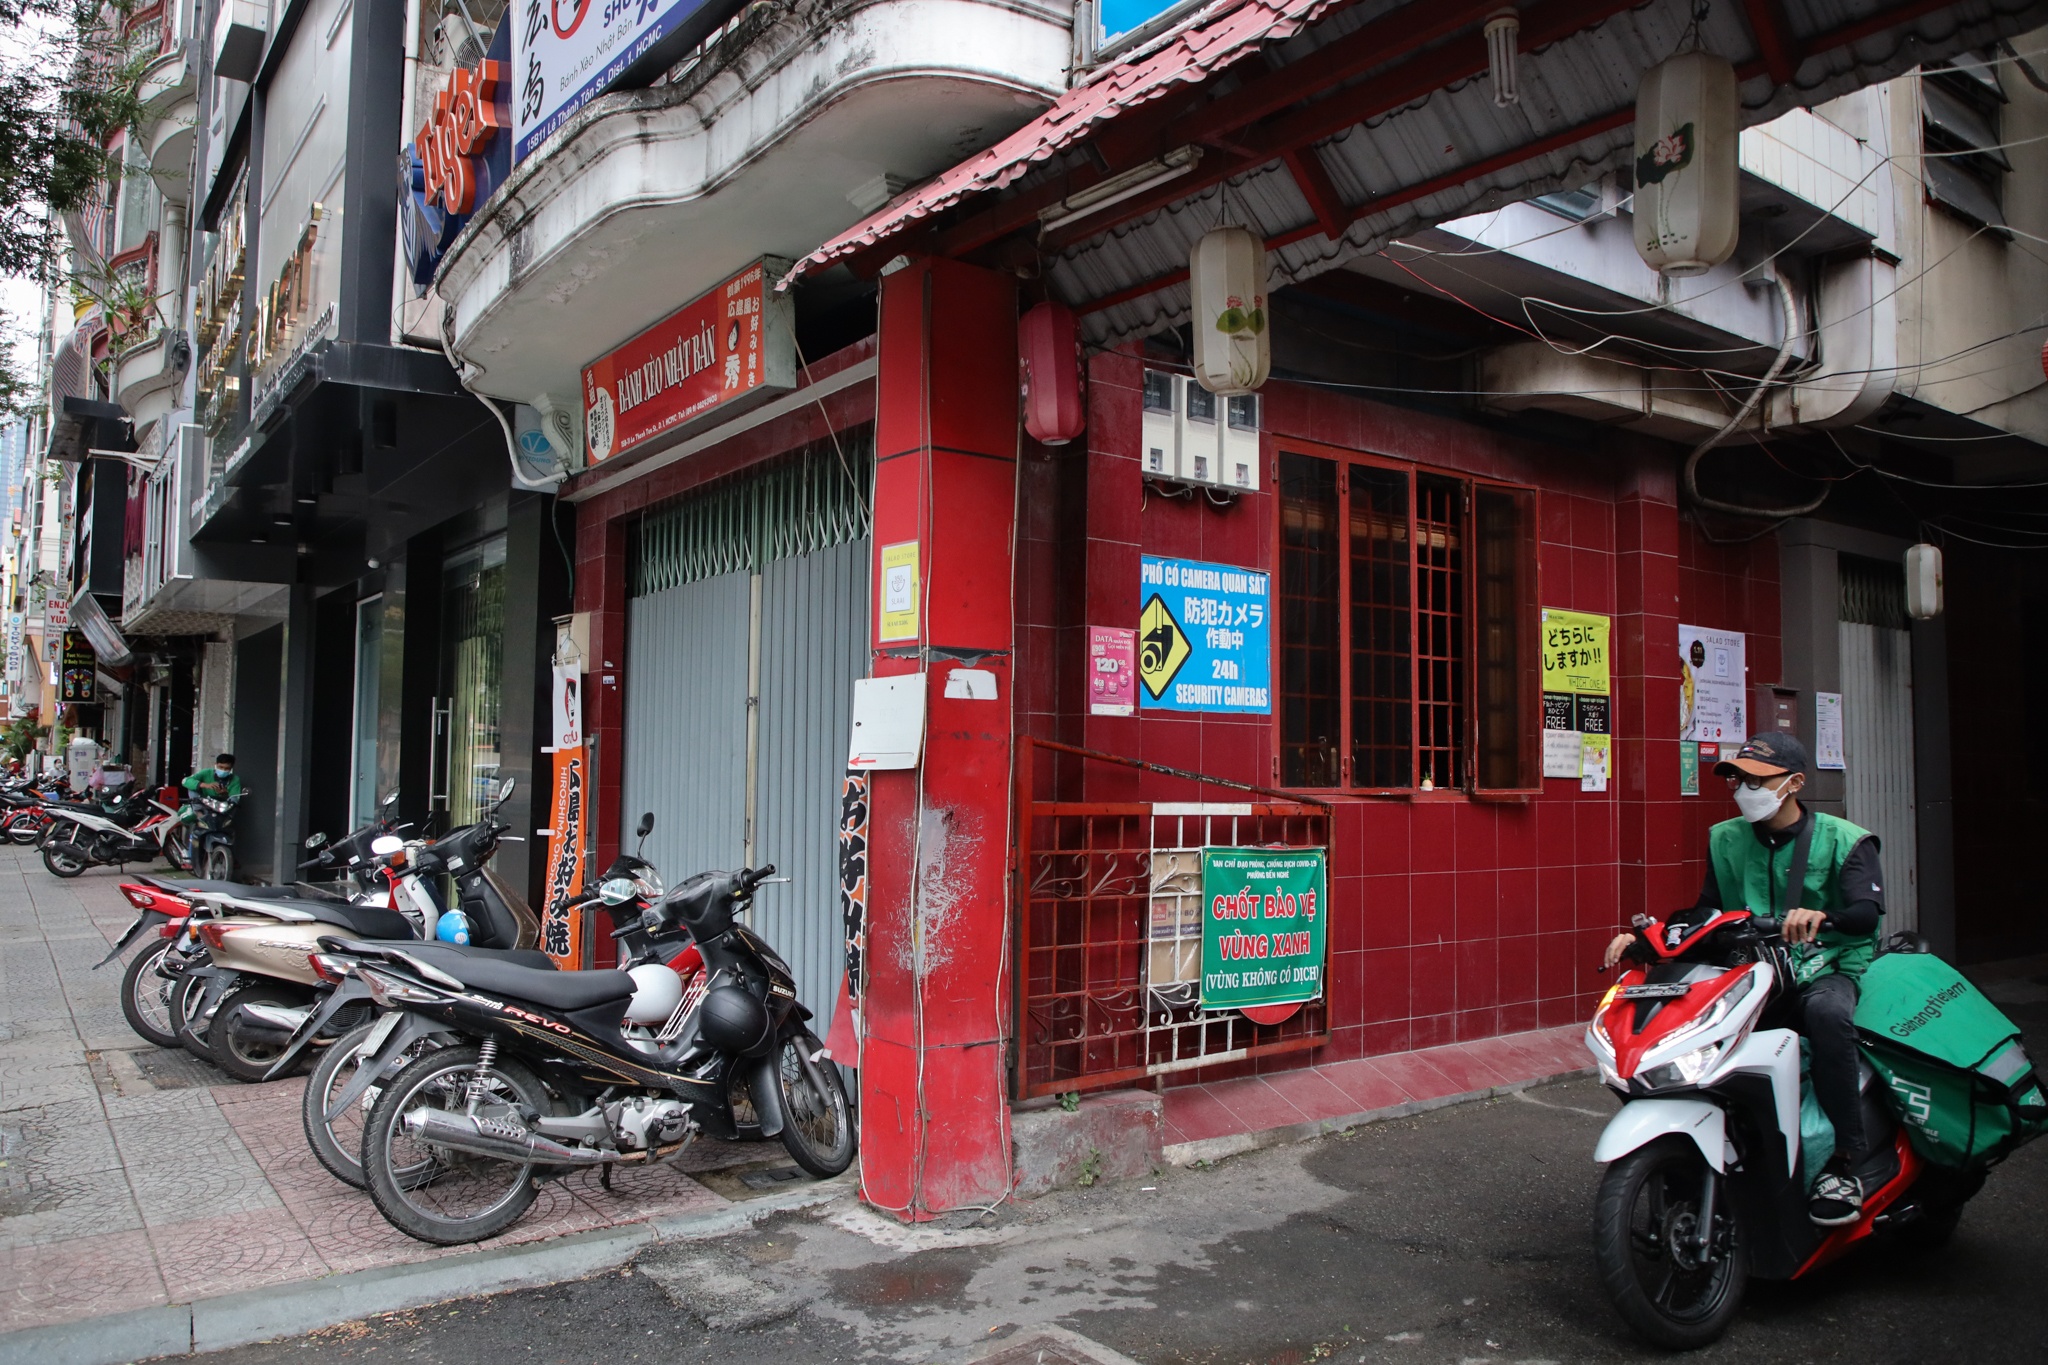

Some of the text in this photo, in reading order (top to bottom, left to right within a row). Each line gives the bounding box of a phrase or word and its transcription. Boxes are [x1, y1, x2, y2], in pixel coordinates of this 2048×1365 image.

[560, 18, 633, 92] Bánh Xèo Nhật Bản
[526, 127, 547, 152] 15B11
[547, 116, 557, 135] Lê
[558, 99, 579, 123] Thánh
[580, 86, 594, 106] Tôn
[595, 75, 606, 93] St.
[607, 61, 627, 86] Dist.
[636, 24, 662, 59] HCMC
[415, 58, 496, 215] Tiger
[617, 319, 717, 415] BÁNH XÈO NHẬT BẢN
[725, 353, 740, 389] 秀
[1142, 561, 1267, 596] PHỐ CÓ CAMERA QUAN SÁT
[1184, 596, 1264, 628] 防犯カメラ
[1095, 635, 1113, 643] DATA
[1206, 627, 1244, 650] 作動中
[1549, 626, 1595, 648] どちらに
[1706, 635, 1741, 647] SALAD STORE
[1095, 657, 1118, 673] 120
[1212, 659, 1239, 680] 24h
[1569, 677, 1587, 688] WHICH
[1175, 683, 1267, 707] SECURITY CAMERAS
[1545, 716, 1567, 730] FREE
[1584, 718, 1604, 732] FREE
[540, 766, 568, 939] HIROSHIMA OKONOMIYAKI
[1224, 858, 1236, 868] CHỈ
[1237, 860, 1248, 869] ĐẠO
[1249, 859, 1265, 869] PHÒNG,
[1266, 859, 1283, 868] CHỐNG
[1284, 860, 1295, 869] DỊCH
[1296, 860, 1318, 868] COVID-19
[1246, 870, 1265, 879] PHƯỜNG
[1266, 869, 1276, 879] BẾN
[1212, 886, 1317, 923] CHỐT BẢO VỆ
[1219, 929, 1311, 961] VÙNG XANH
[1205, 965, 1319, 992] (VÙNG KHÔNG CÓ DỊCH)
[773, 985, 794, 997] SUZUKI
[503, 1005, 572, 1035] REVO
